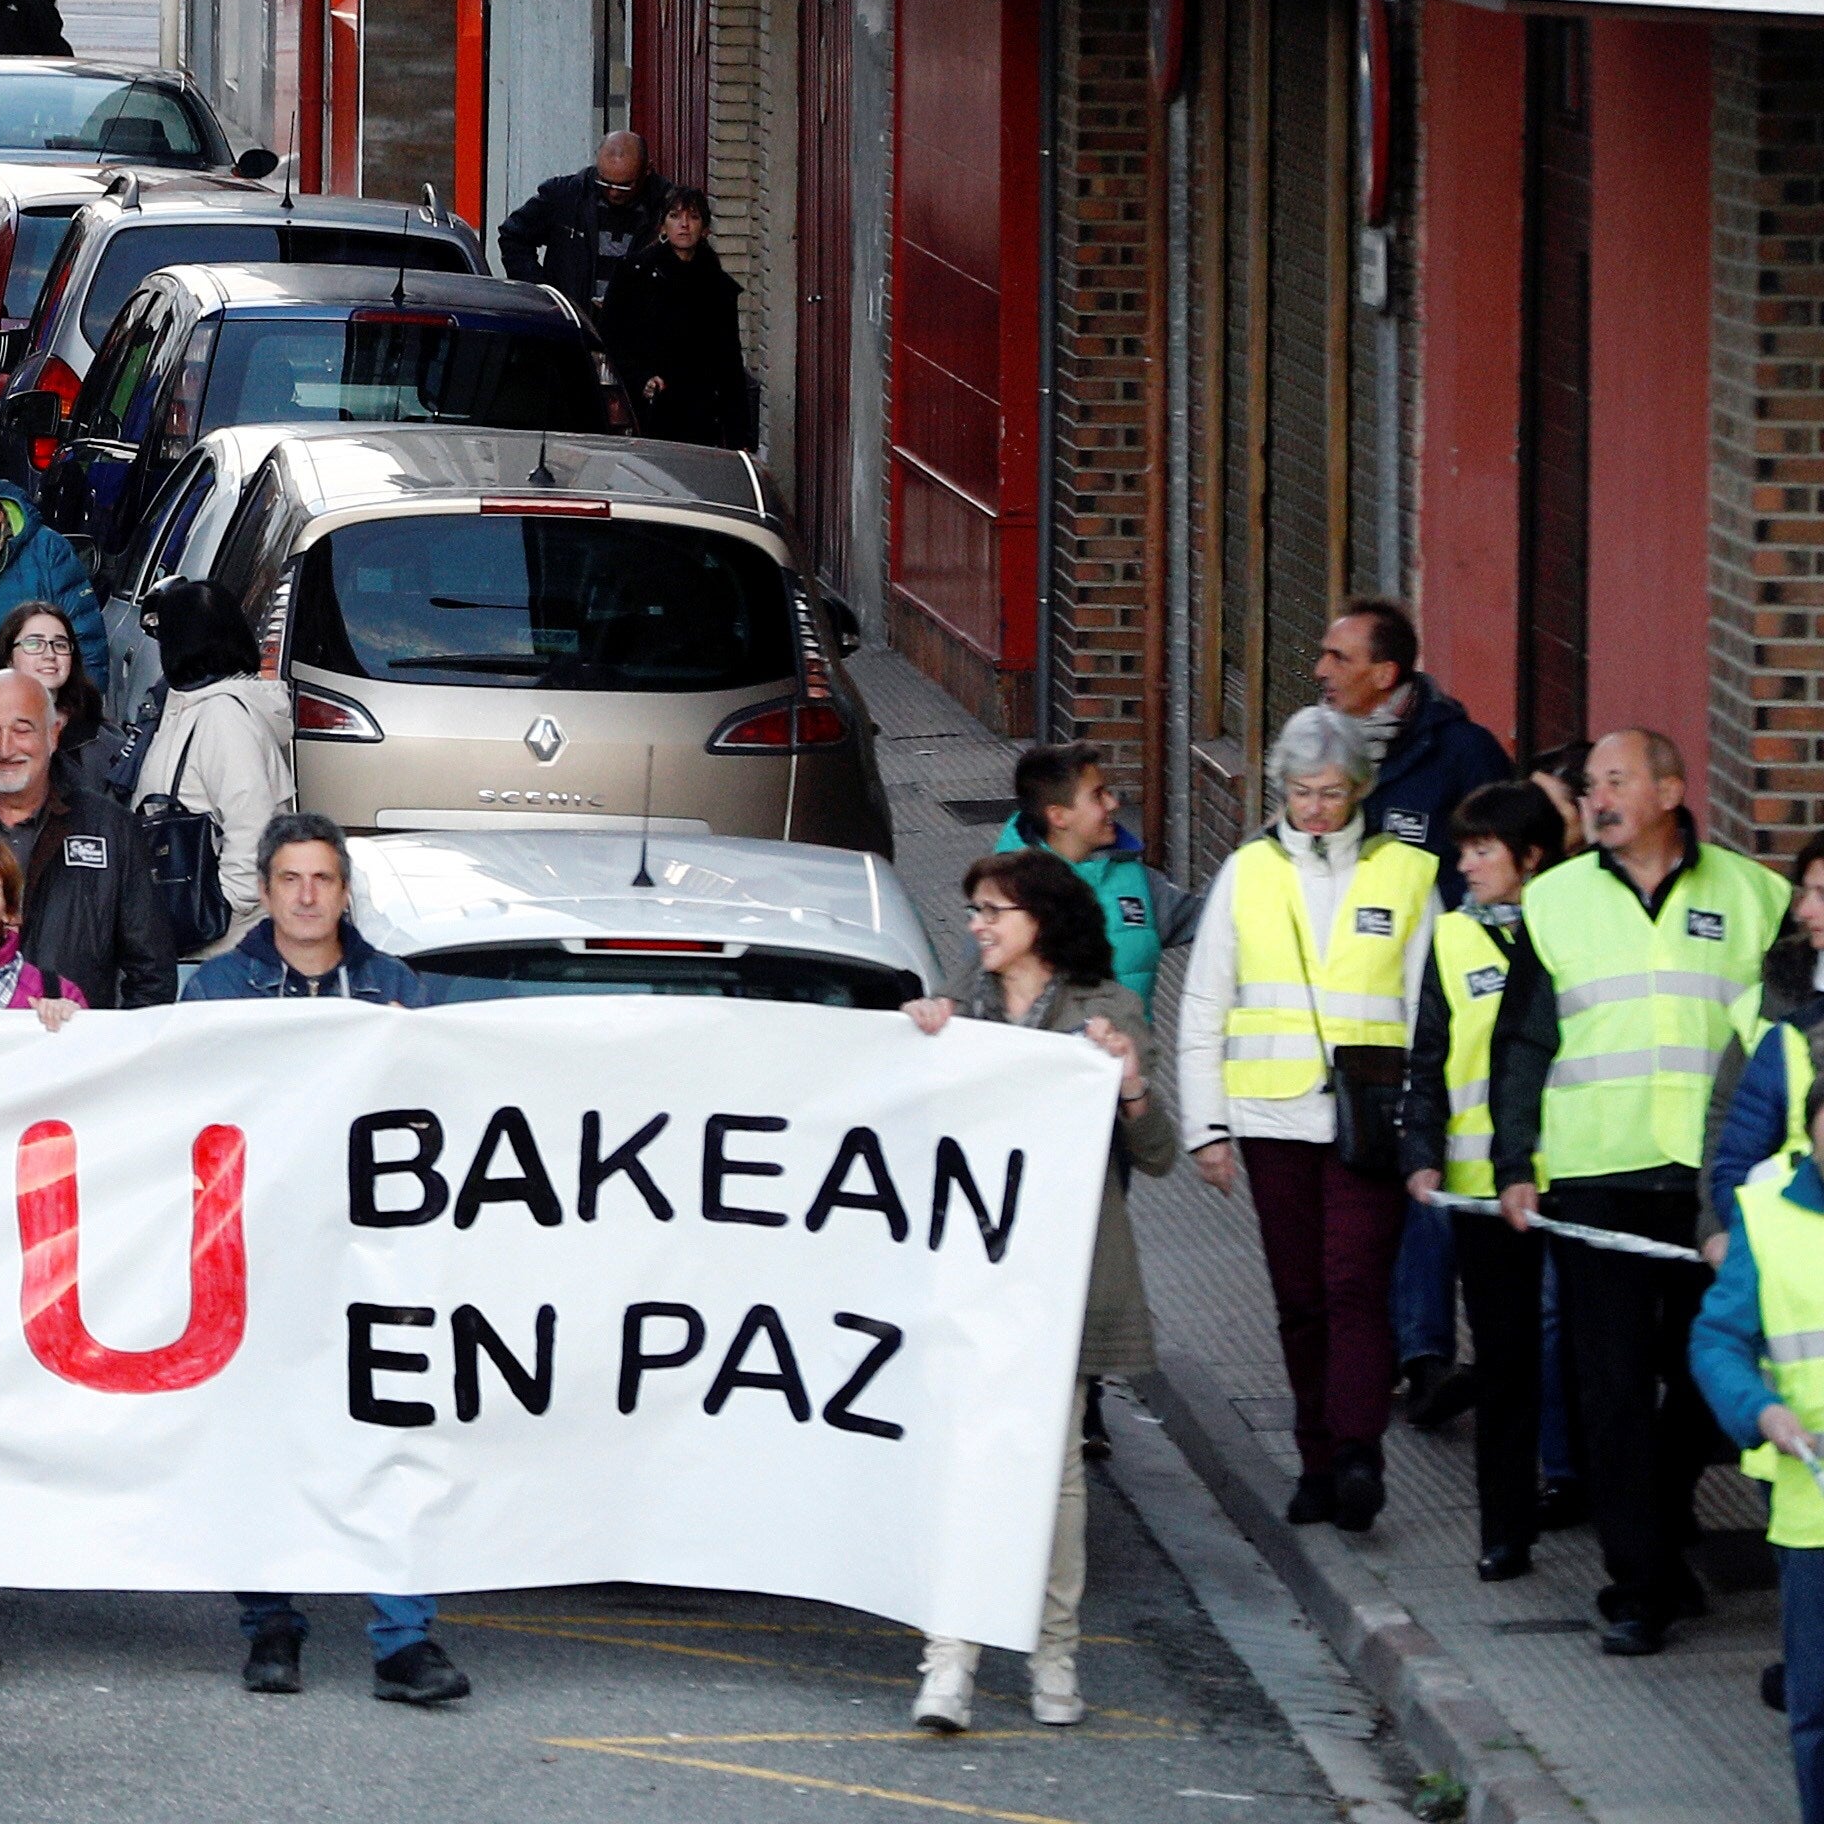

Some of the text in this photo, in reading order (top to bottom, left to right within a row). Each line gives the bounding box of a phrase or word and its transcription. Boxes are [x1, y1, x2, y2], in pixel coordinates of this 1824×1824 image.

[477, 788, 605, 808] SCENIC
[346, 1105, 1026, 1265] BAKEAN
[345, 1300, 905, 1442] EN PAZ
